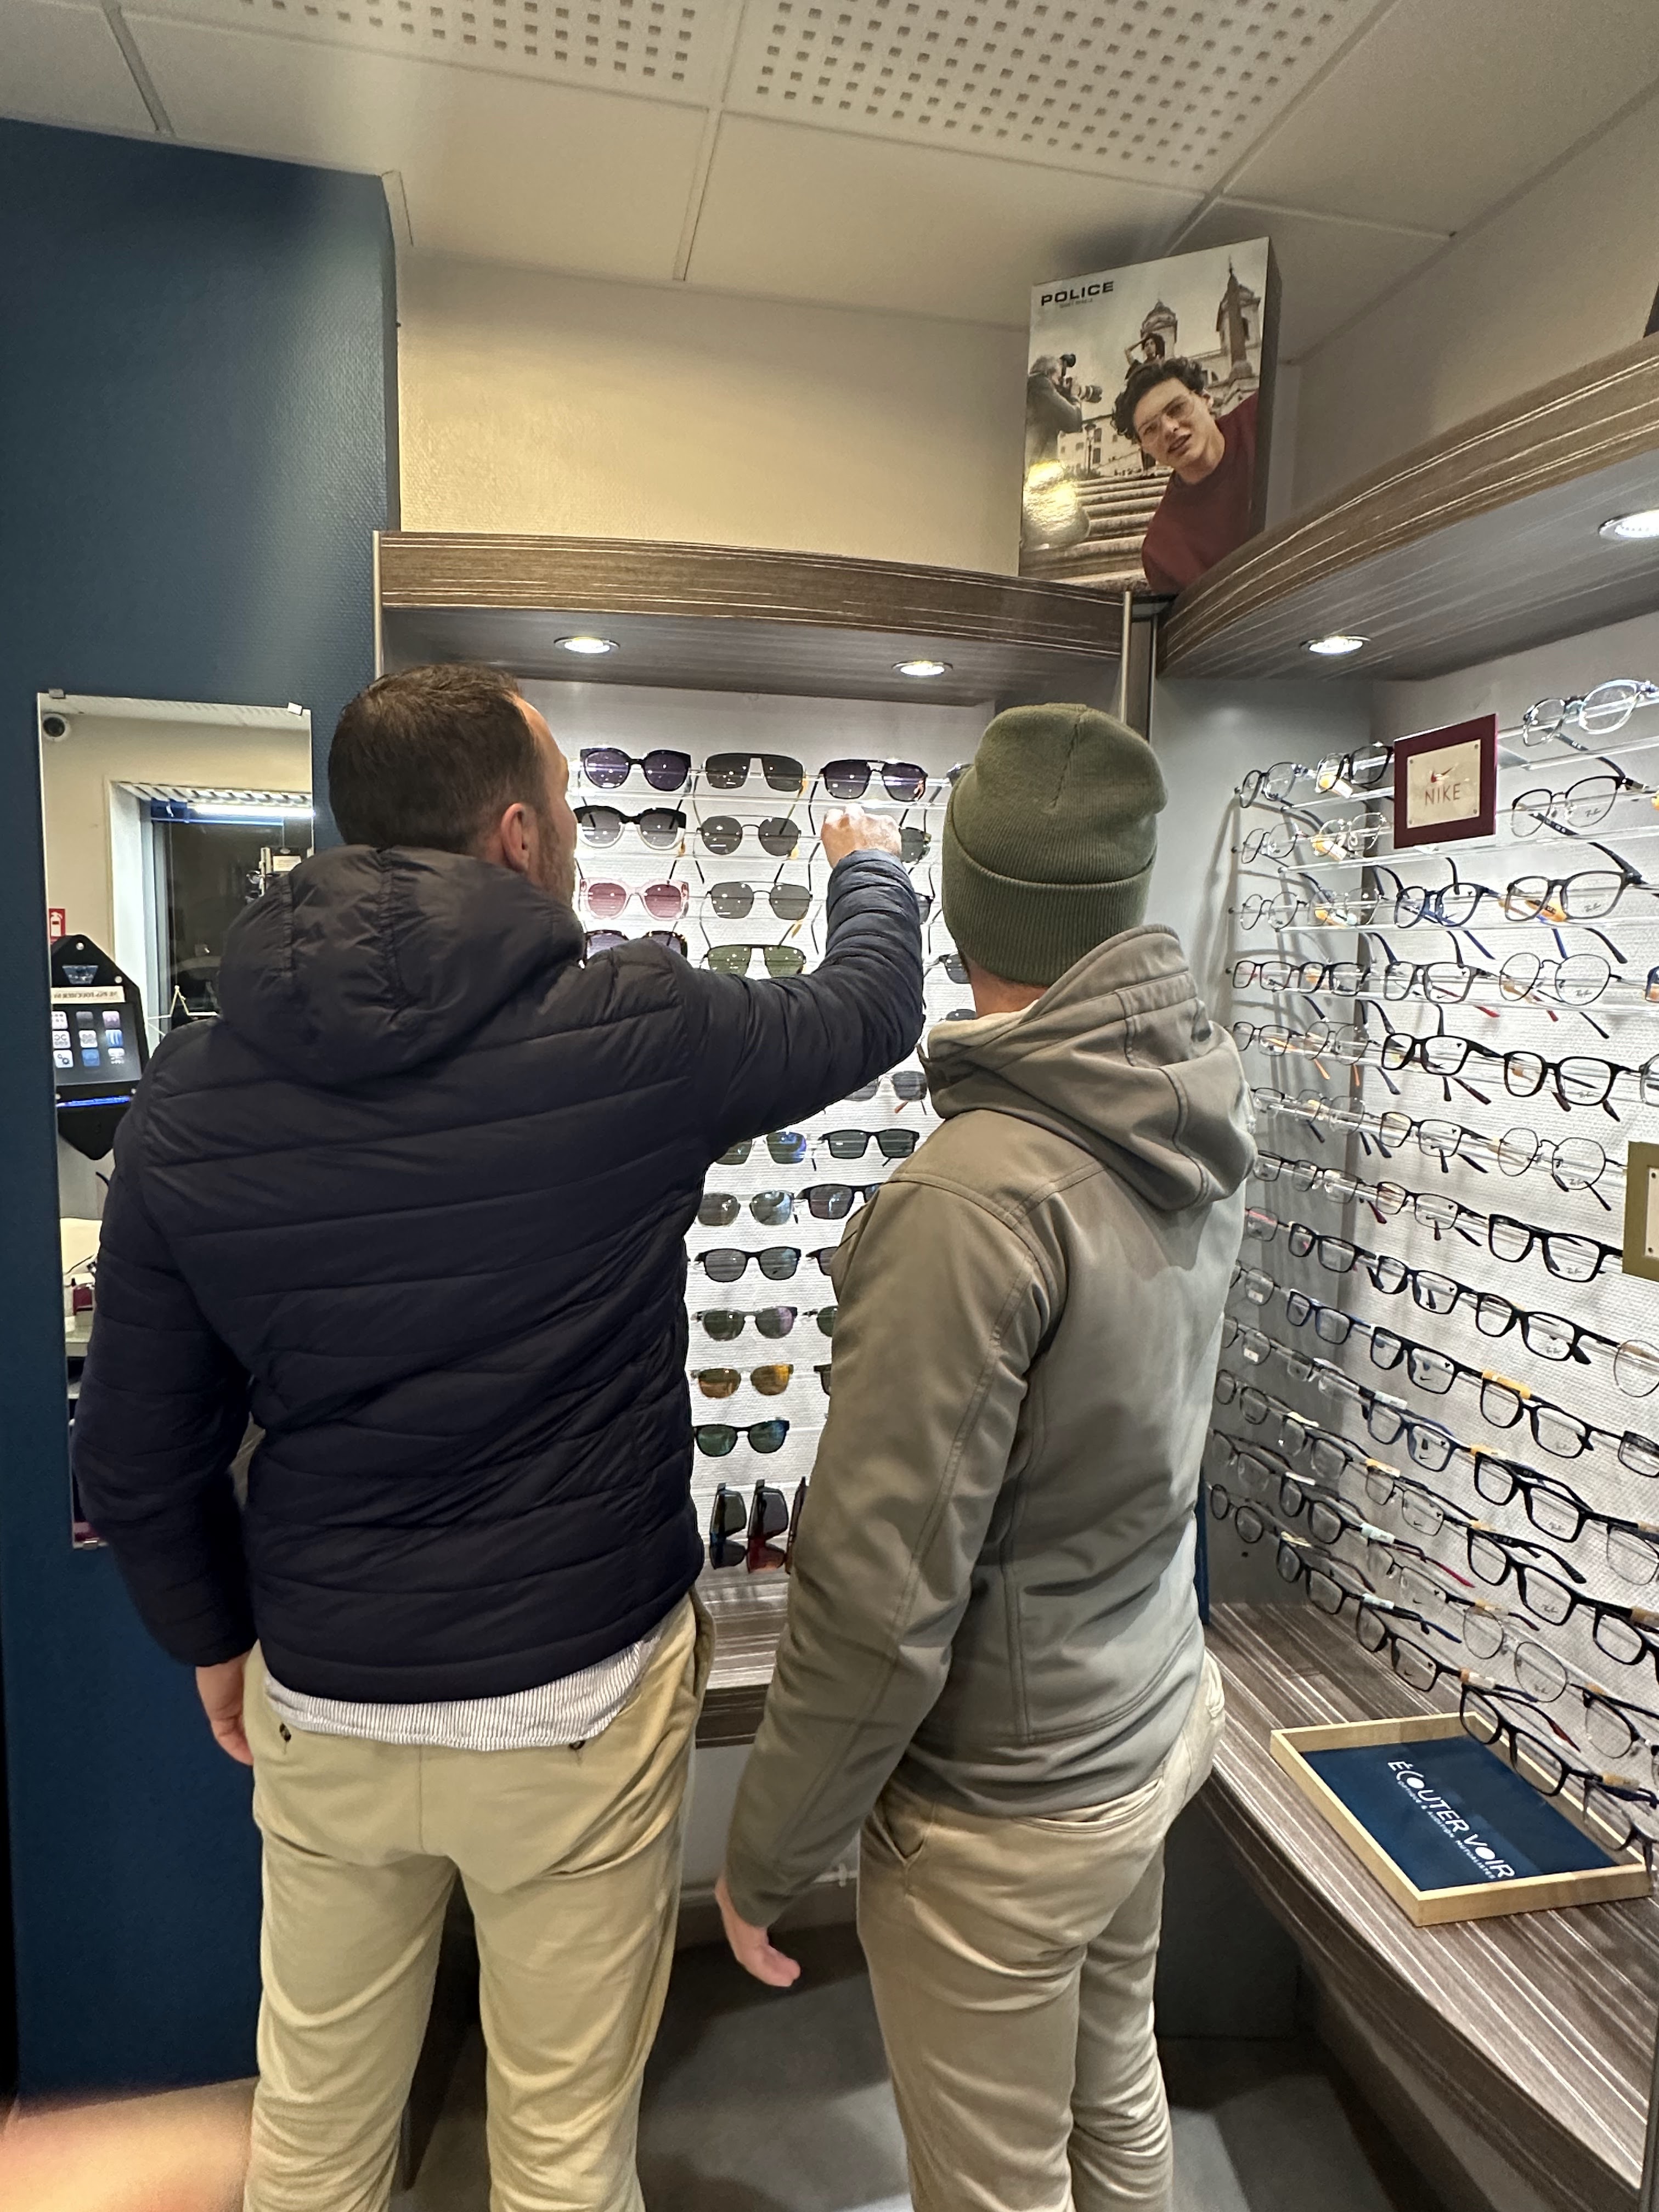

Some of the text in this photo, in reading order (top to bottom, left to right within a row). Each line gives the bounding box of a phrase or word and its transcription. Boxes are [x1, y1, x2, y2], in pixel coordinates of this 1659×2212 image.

[1041, 281, 1114, 306] POLICE
[1425, 783, 1461, 806] NIKE
[1387, 1761, 1515, 1877] ÉCOUTER VOIR
[1397, 1781, 1422, 1803] OPTIQUE
[1427, 1811, 1454, 1838] AUDITION
[1455, 1840, 1496, 1879] MUTUALISTES
